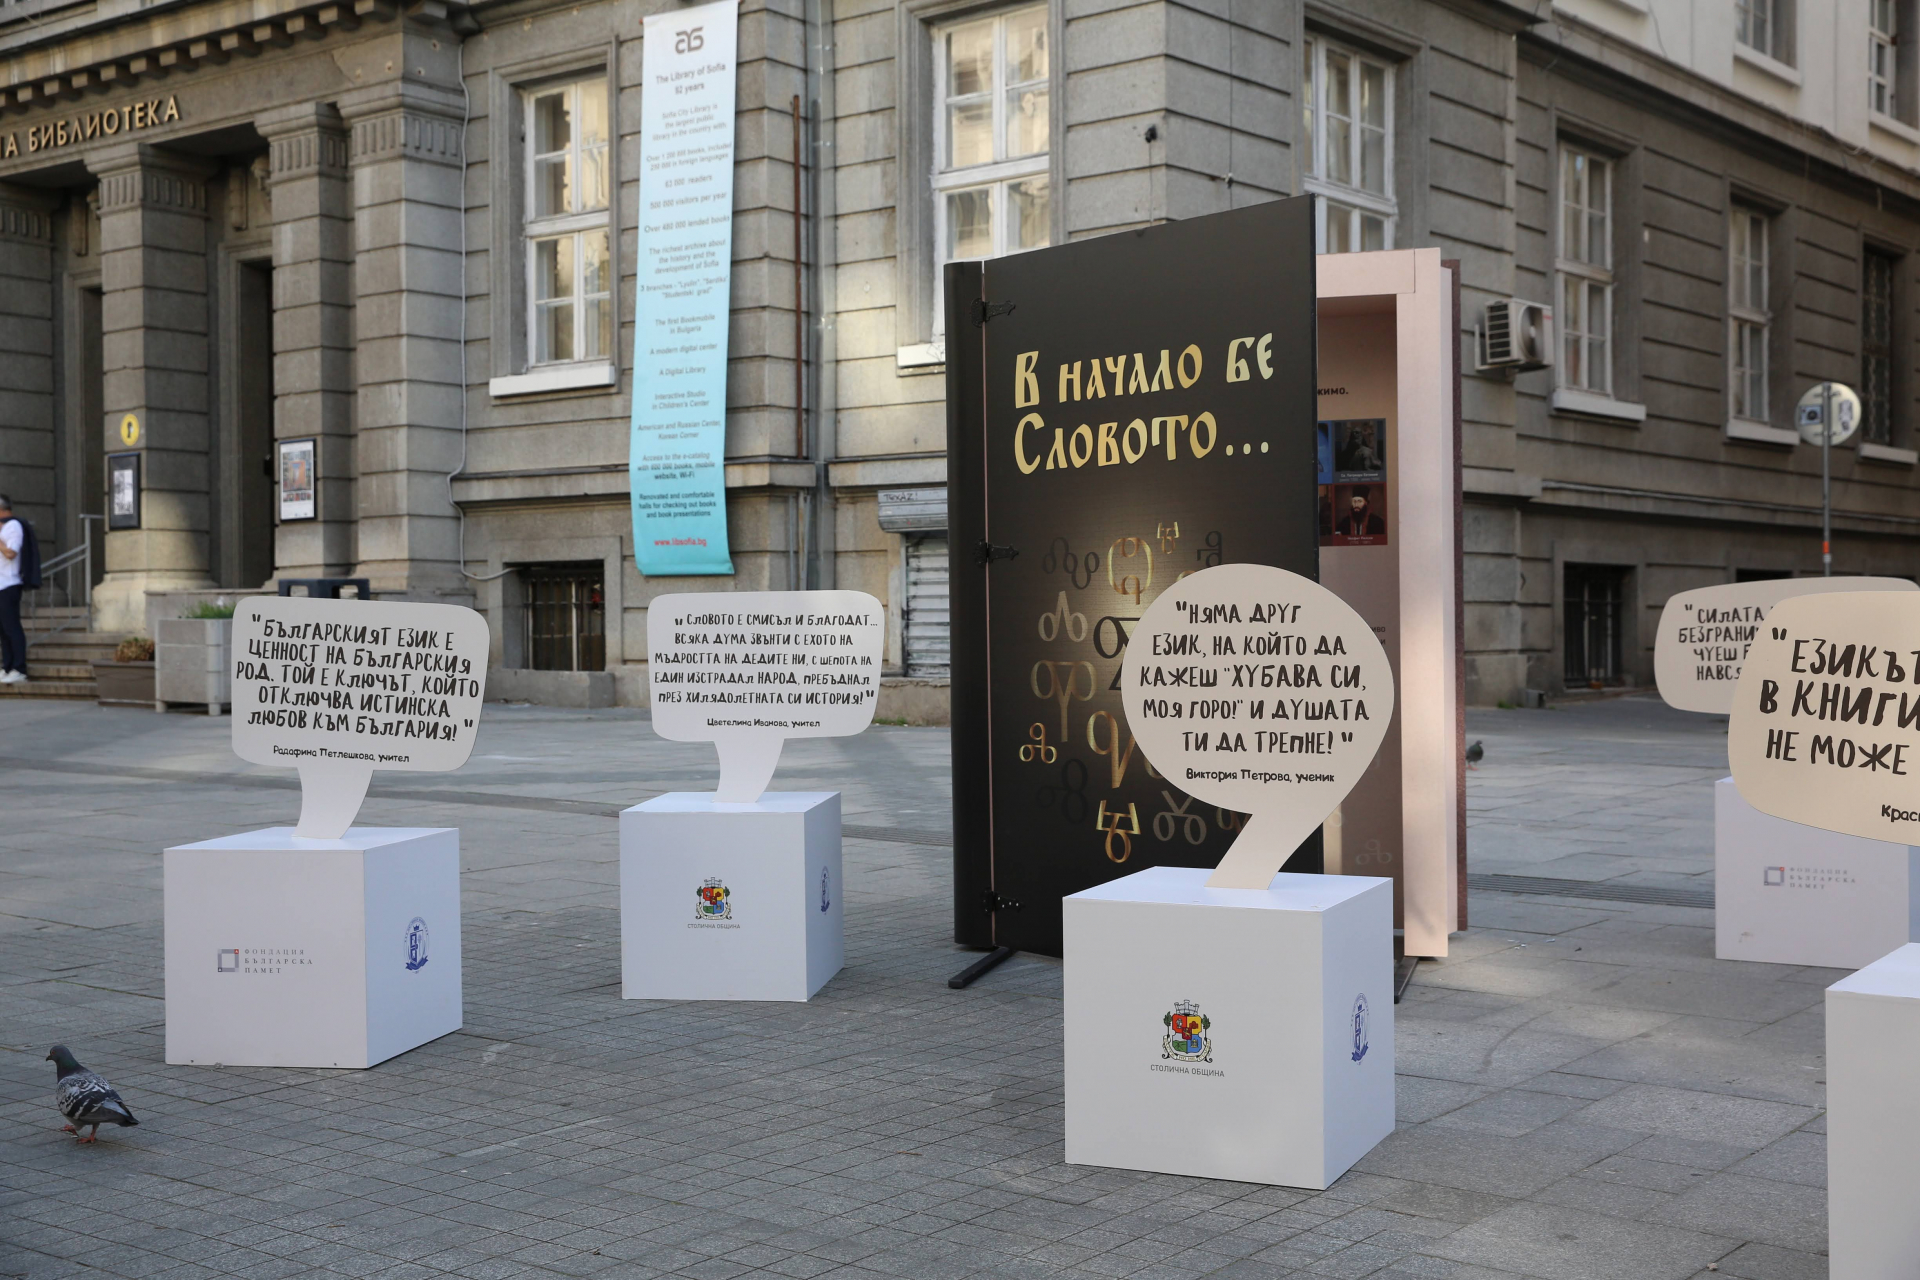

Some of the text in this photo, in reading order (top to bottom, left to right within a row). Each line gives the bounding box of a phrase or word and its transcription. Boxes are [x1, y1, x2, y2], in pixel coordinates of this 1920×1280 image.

[656, 63, 726, 84] The Library of Sofia
[685, 81, 704, 94] years
[0, 94, 179, 159] А БИБЛИОТЕКА
[655, 264, 694, 274] development
[704, 260, 719, 268] Sofia
[680, 344, 698, 353] digital
[665, 367, 684, 376] Digital
[685, 366, 706, 374] Library
[1014, 350, 1040, 409] В
[655, 392, 685, 400] Interactive
[673, 510, 711, 519] presentations
[654, 538, 707, 547] www.libsofia.bg
[1176, 601, 1301, 623] "НЯМА ДРУГ
[738, 614, 742, 625] Е
[747, 614, 791, 625] СМИСЪЛ
[796, 615, 803, 625] И
[807, 614, 878, 627] БЛАГОДАТ...
[398, 628, 439, 649] ЕЗИК
[446, 633, 454, 650] Е
[675, 633, 853, 645] ВСЯКА ДУМА ЗВЪНТИ С ЕХОТО НА
[1679, 626, 1759, 643] БЕЗГРАНИ
[1153, 632, 1346, 658] ЕЗИК, НА КОЙТО ДА
[249, 638, 470, 674] ЦЕННОСТ НА БЪЛГАРСКИЯ
[655, 653, 872, 667] МЪДРОСТТА НА ДЕДИТЕ НИ, С ШЕПОТА НА
[1694, 647, 1737, 661] ЧУЕШ
[237, 661, 479, 697] РОД. ТОЙ Е КЛЮЧЪТ, КОЙТО
[655, 672, 869, 686] ЕДИН ИЗСТРАДАЛ НАРОД, ПРЕБЪДНАЛ
[1140, 664, 1366, 691] КАЖЕШ "ХУБАВА СИ,
[259, 686, 450, 717] ОТКЛЮЧВА ИСТИНСКА
[659, 691, 681, 702] ПРЕЗ
[686, 692, 784, 703] ХИЛЯДОЛЕТНАТА
[788, 693, 801, 704] СИ
[1760, 680, 1779, 714] В
[1144, 699, 1369, 721] МОЯ ГОРО!" И ДУШАТА
[248, 710, 307, 728] ЛЮБОВ
[313, 712, 349, 731] КЪМ
[708, 718, 751, 726] Цветелина
[754, 719, 789, 727] Иванова,
[1182, 732, 1208, 751] ТИ
[1216, 732, 1247, 752] ДА
[274, 745, 316, 757] Радафина
[320, 748, 376, 761] Петлешкова,
[1766, 729, 1909, 775] НЕ МОЖЕ
[1186, 768, 1334, 783] Виктория Петрова, ученик
[1882, 805, 1920, 822] Крас
[1790, 867, 1847, 875] ФОНДАЦИЯ
[1790, 875, 1855, 883] БЪЛГАРСКА
[1151, 1064, 1224, 1077] СТОЛИЧНА ОБЩИНА
